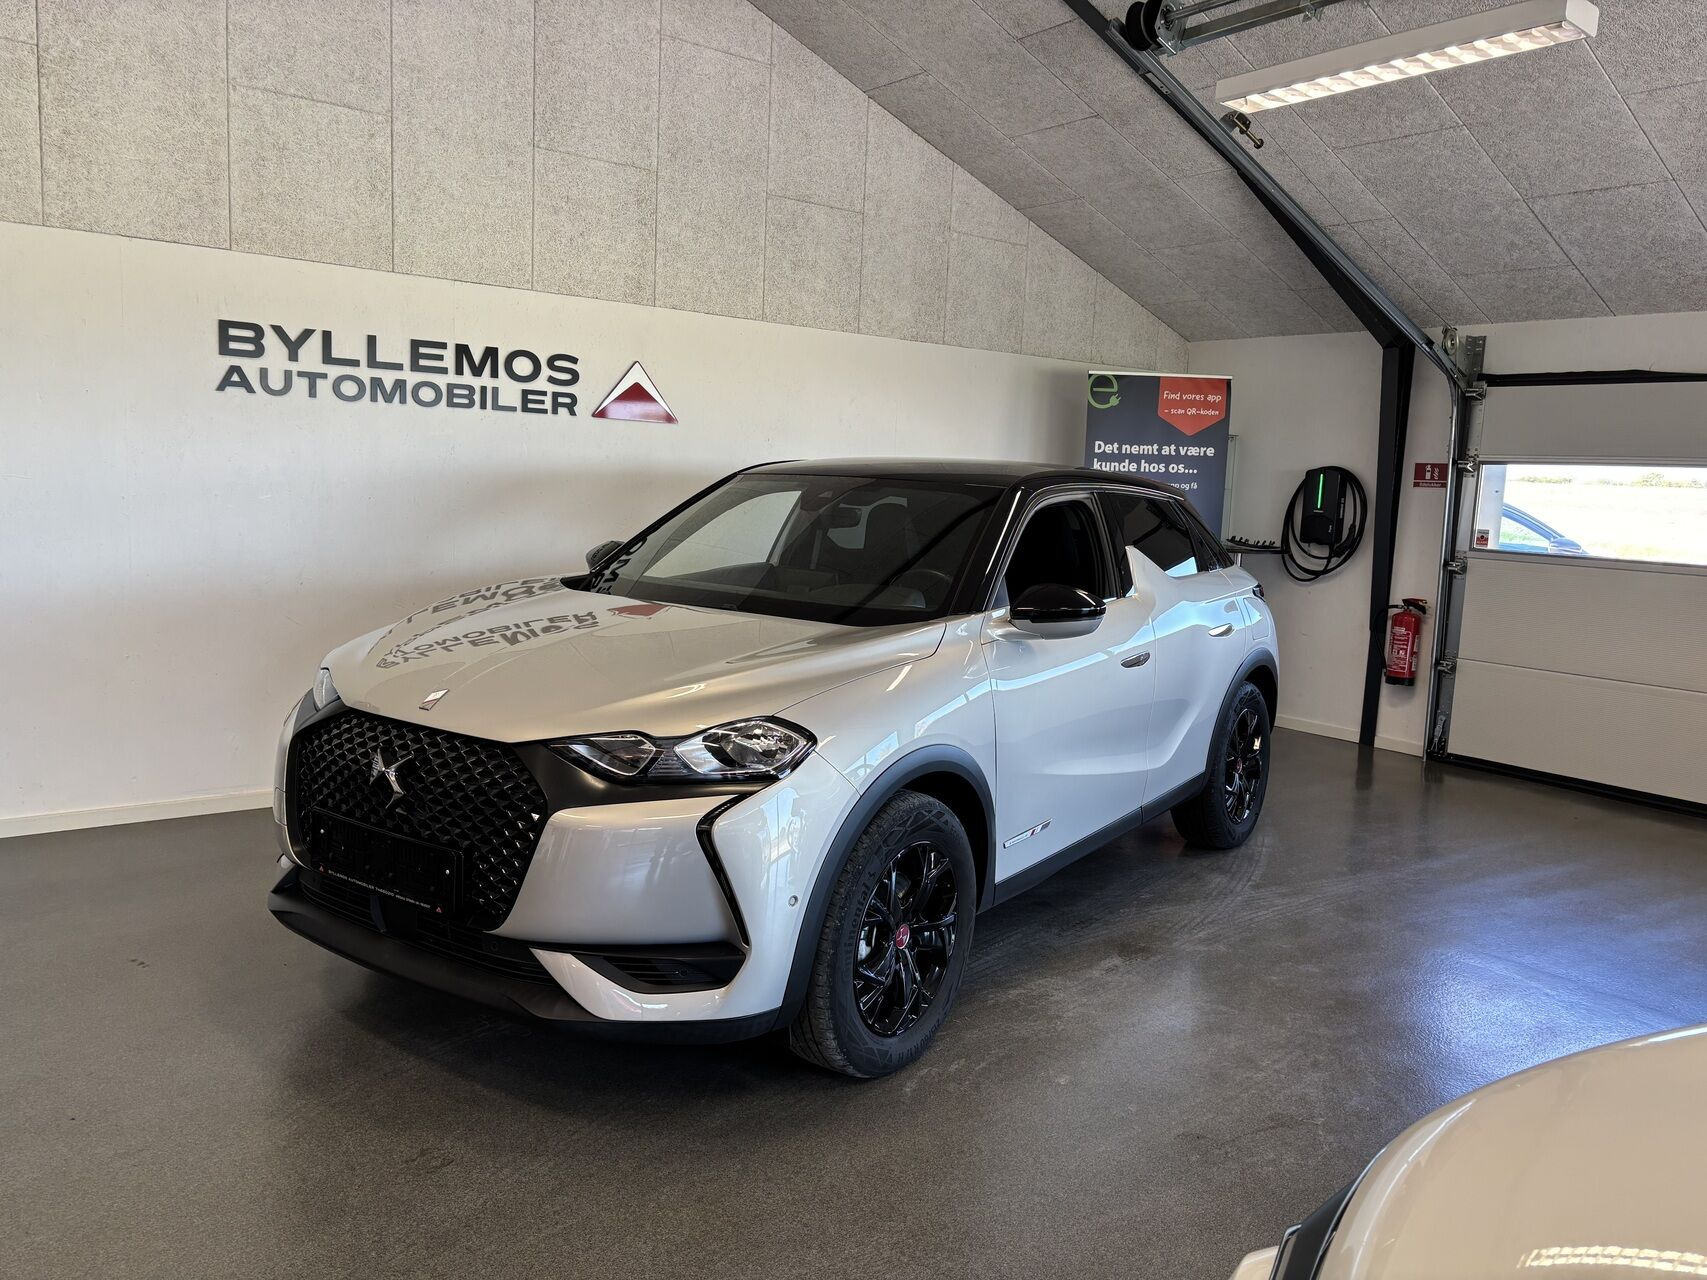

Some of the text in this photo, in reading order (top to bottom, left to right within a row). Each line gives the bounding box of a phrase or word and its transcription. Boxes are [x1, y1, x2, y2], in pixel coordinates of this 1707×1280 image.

[218, 319, 580, 386] BYLLEMOS
[215, 365, 578, 416] AUTOMOBILER
[1163, 391, 1222, 403] Find vores app
[1186, 408, 1219, 416] QR-koden
[1094, 441, 1215, 457] Det nemt at være
[1093, 458, 1198, 474] kunde hos os...
[1180, 483, 1190, 491] og
